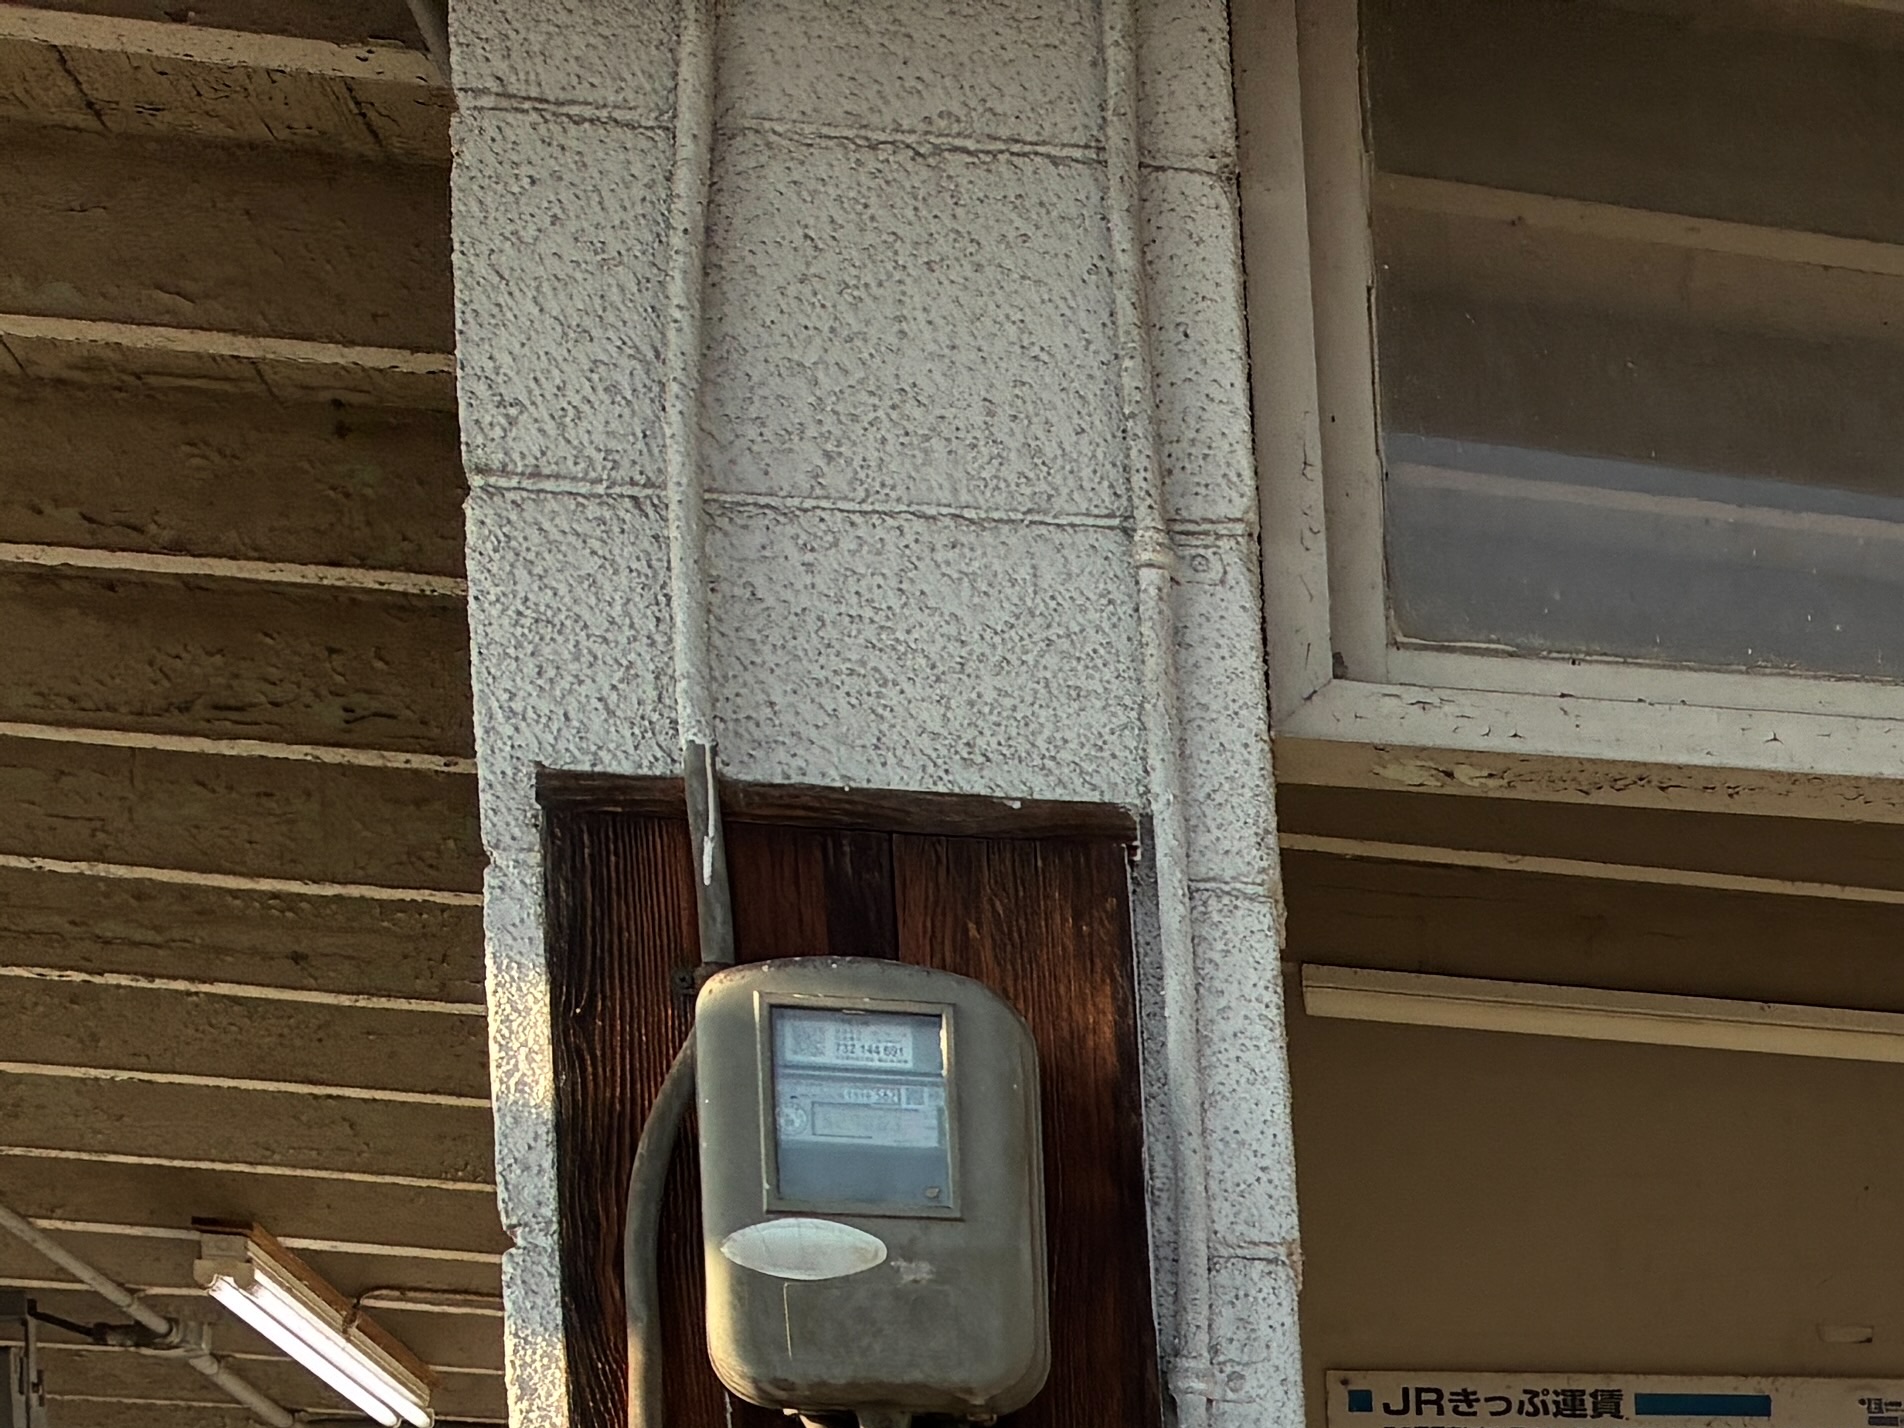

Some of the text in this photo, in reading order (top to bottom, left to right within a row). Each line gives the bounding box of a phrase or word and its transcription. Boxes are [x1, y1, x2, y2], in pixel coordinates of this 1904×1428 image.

[1382, 1386, 1624, 1419] JRきっぷ運賃
